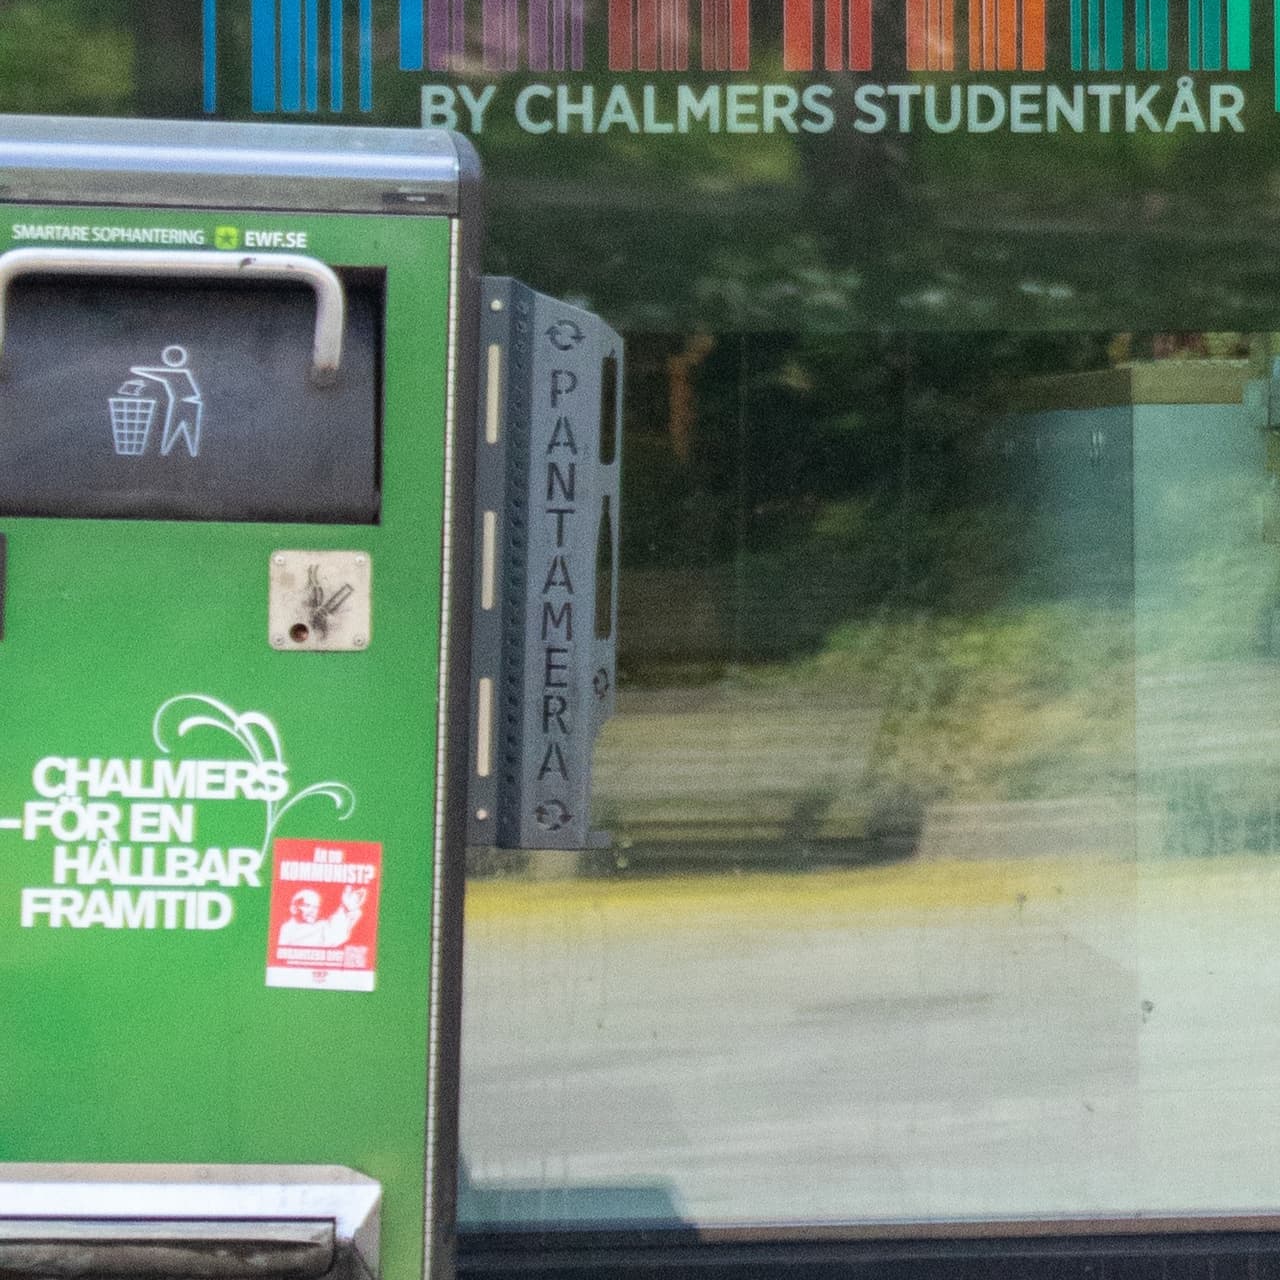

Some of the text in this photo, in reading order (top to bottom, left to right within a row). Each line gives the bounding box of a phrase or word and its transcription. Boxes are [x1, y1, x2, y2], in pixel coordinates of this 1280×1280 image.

[419, 76, 1246, 135] BY CHALMERS STUDENTKÅR
[12, 223, 307, 249] SMARTARE SOPHANTERING EWF.SE
[536, 369, 579, 781] PANTAMERA
[32, 756, 289, 801] CHALMERS
[23, 796, 194, 843] FÖR EN
[54, 838, 261, 887] HÅLLBAR
[20, 888, 234, 930] FRAMTID
